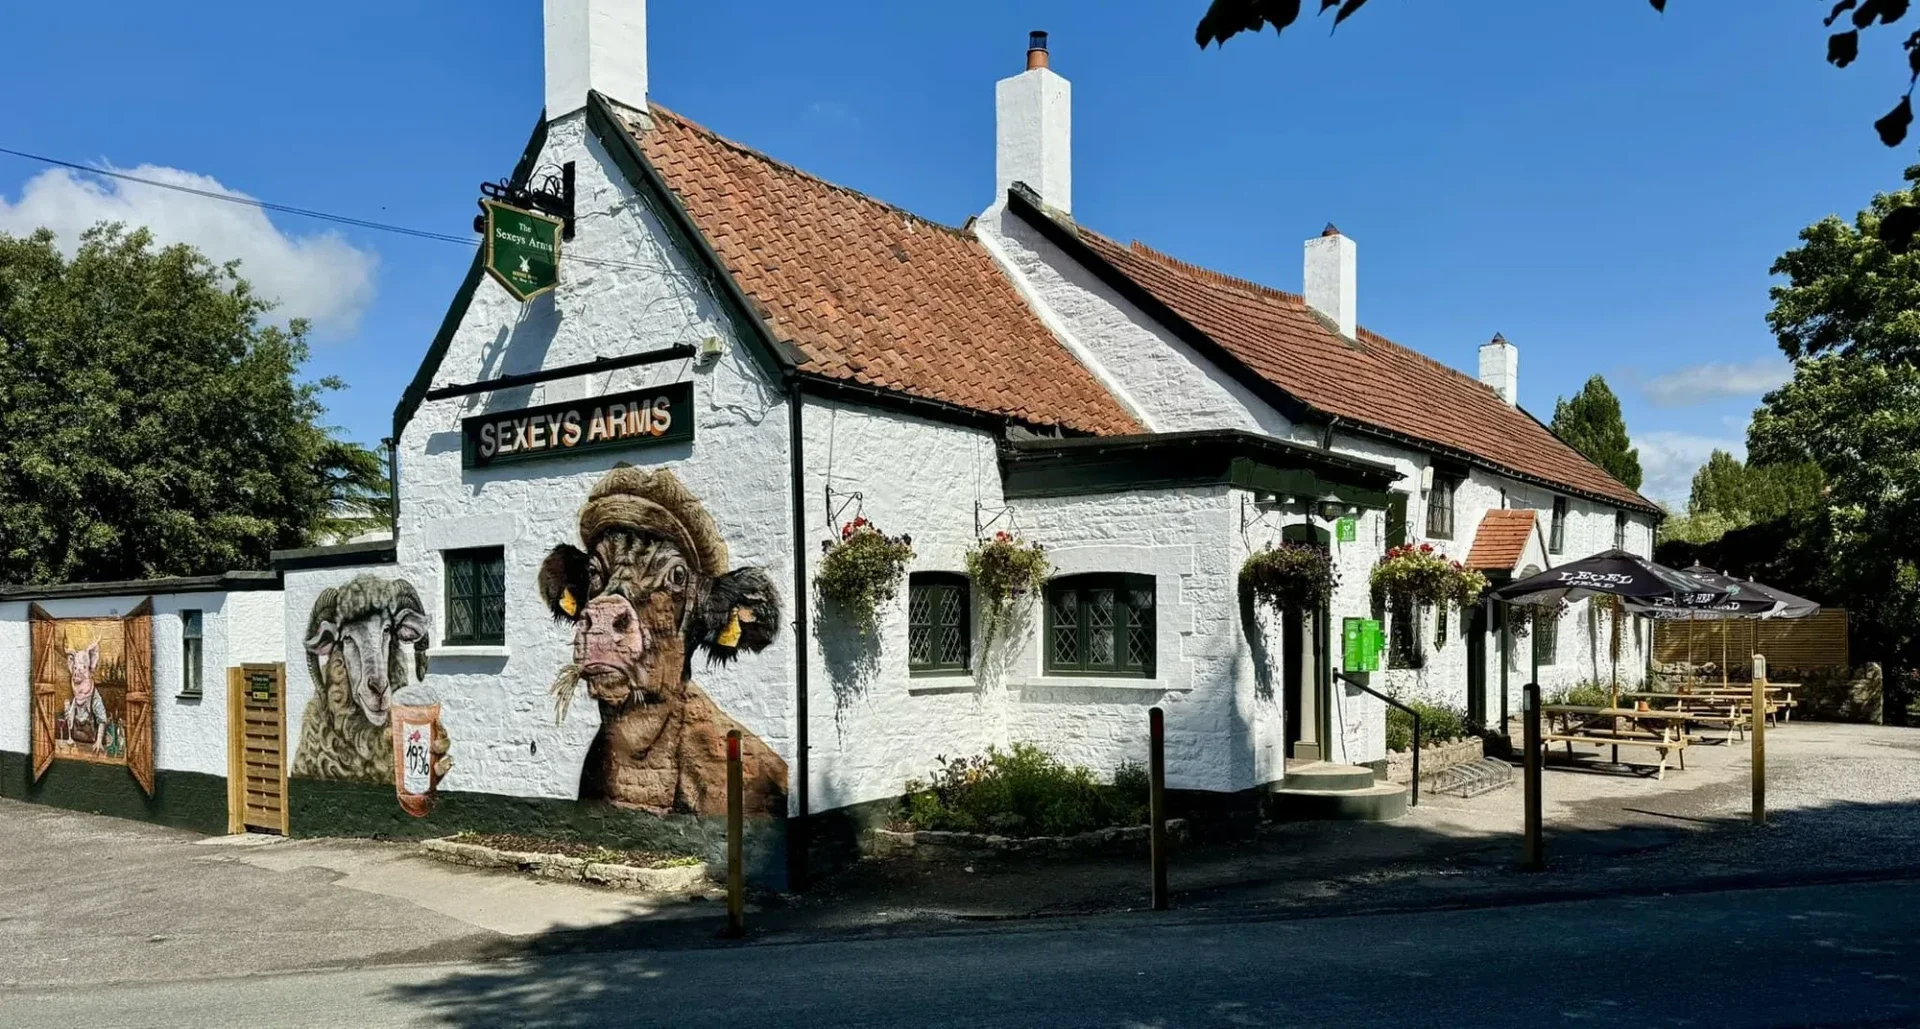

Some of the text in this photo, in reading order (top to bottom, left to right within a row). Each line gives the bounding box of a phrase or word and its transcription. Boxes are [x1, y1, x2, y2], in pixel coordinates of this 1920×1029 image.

[496, 227, 553, 252] Sexeys Arms
[518, 222, 531, 232] The
[480, 396, 671, 458] SEXEYS ARMS
[406, 741, 430, 776] 1936
